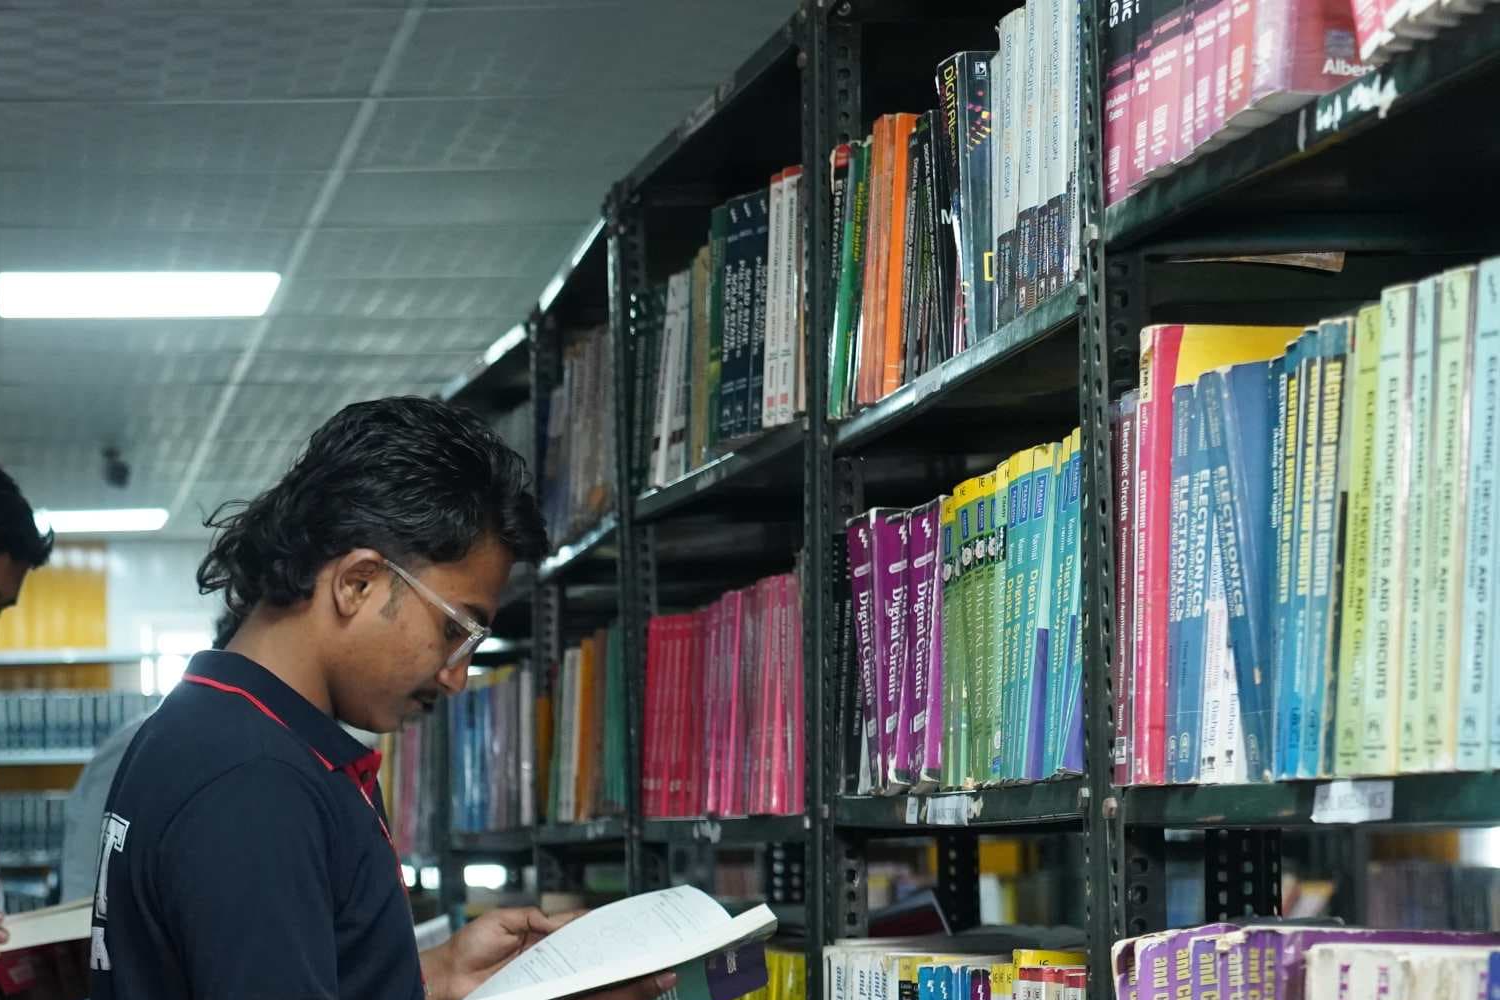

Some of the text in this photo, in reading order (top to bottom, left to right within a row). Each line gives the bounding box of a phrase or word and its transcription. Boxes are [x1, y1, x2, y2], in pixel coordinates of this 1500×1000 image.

[943, 65, 957, 136] DIGITAL
[831, 179, 844, 280] Electronics
[1120, 420, 1131, 522] Electronic Circuits
[1444, 360, 1459, 473] ELECTRONIC
[1175, 474, 1189, 622] ELECTRONICS
[1191, 468, 1211, 618] ELECTRONICS
[1217, 465, 1245, 617] ELECTRONICS
[1375, 376, 1399, 700] ELECTRONIC DEVICES AND CIRCUITS
[1471, 356, 1498, 695] ELECTRONIC DEVICES AND CIRCUITS
[857, 591, 873, 705] Digital Circuits
[888, 587, 904, 702] Digital Circuits
[913, 581, 929, 700] Digital Circuits
[1022, 568, 1039, 680] Digital Systems
[1153, 956, 1169, 989] and
[1176, 948, 1192, 982] and
[1199, 952, 1219, 986] and
[1228, 953, 1244, 987] and
